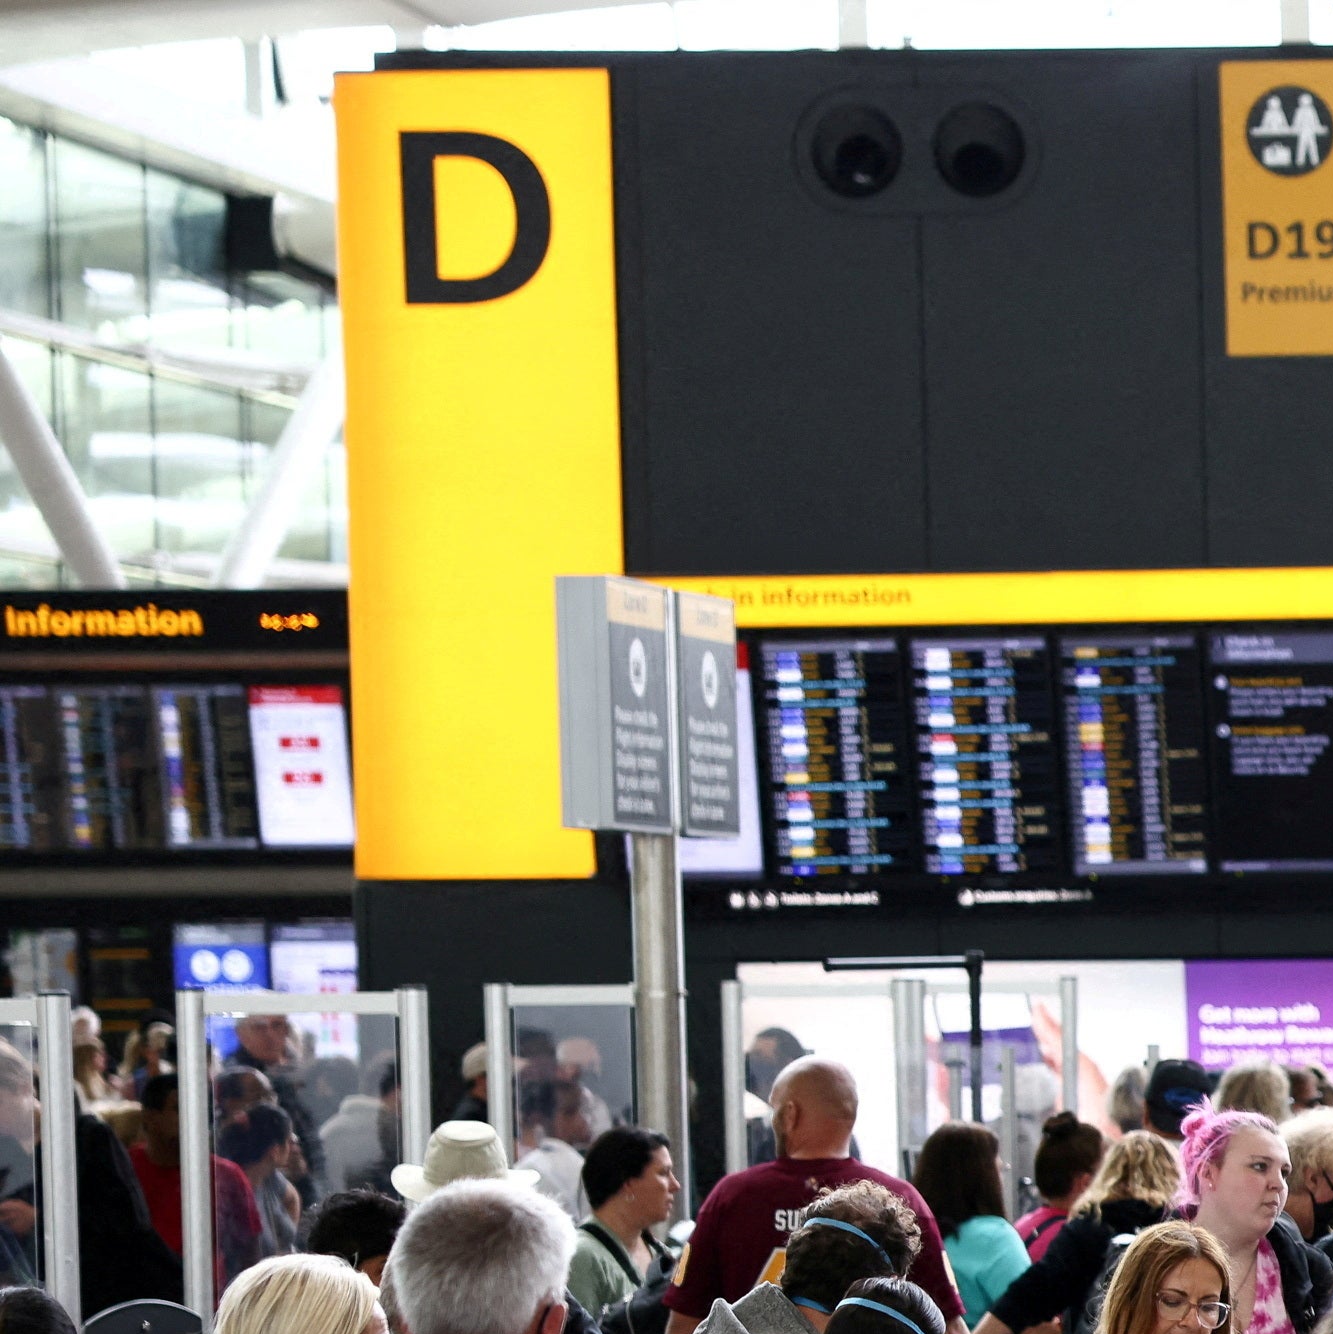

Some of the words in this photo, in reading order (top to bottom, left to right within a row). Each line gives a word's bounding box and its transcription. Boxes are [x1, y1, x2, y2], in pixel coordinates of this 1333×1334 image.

[399, 131, 551, 304] D
[762, 582, 912, 606] information
[4, 603, 205, 637] Information
[1198, 1003, 1232, 1024] Get
[1232, 1007, 1278, 1024] more
[1279, 1002, 1320, 1023] with
[1199, 1025, 1284, 1046] Heathrow
